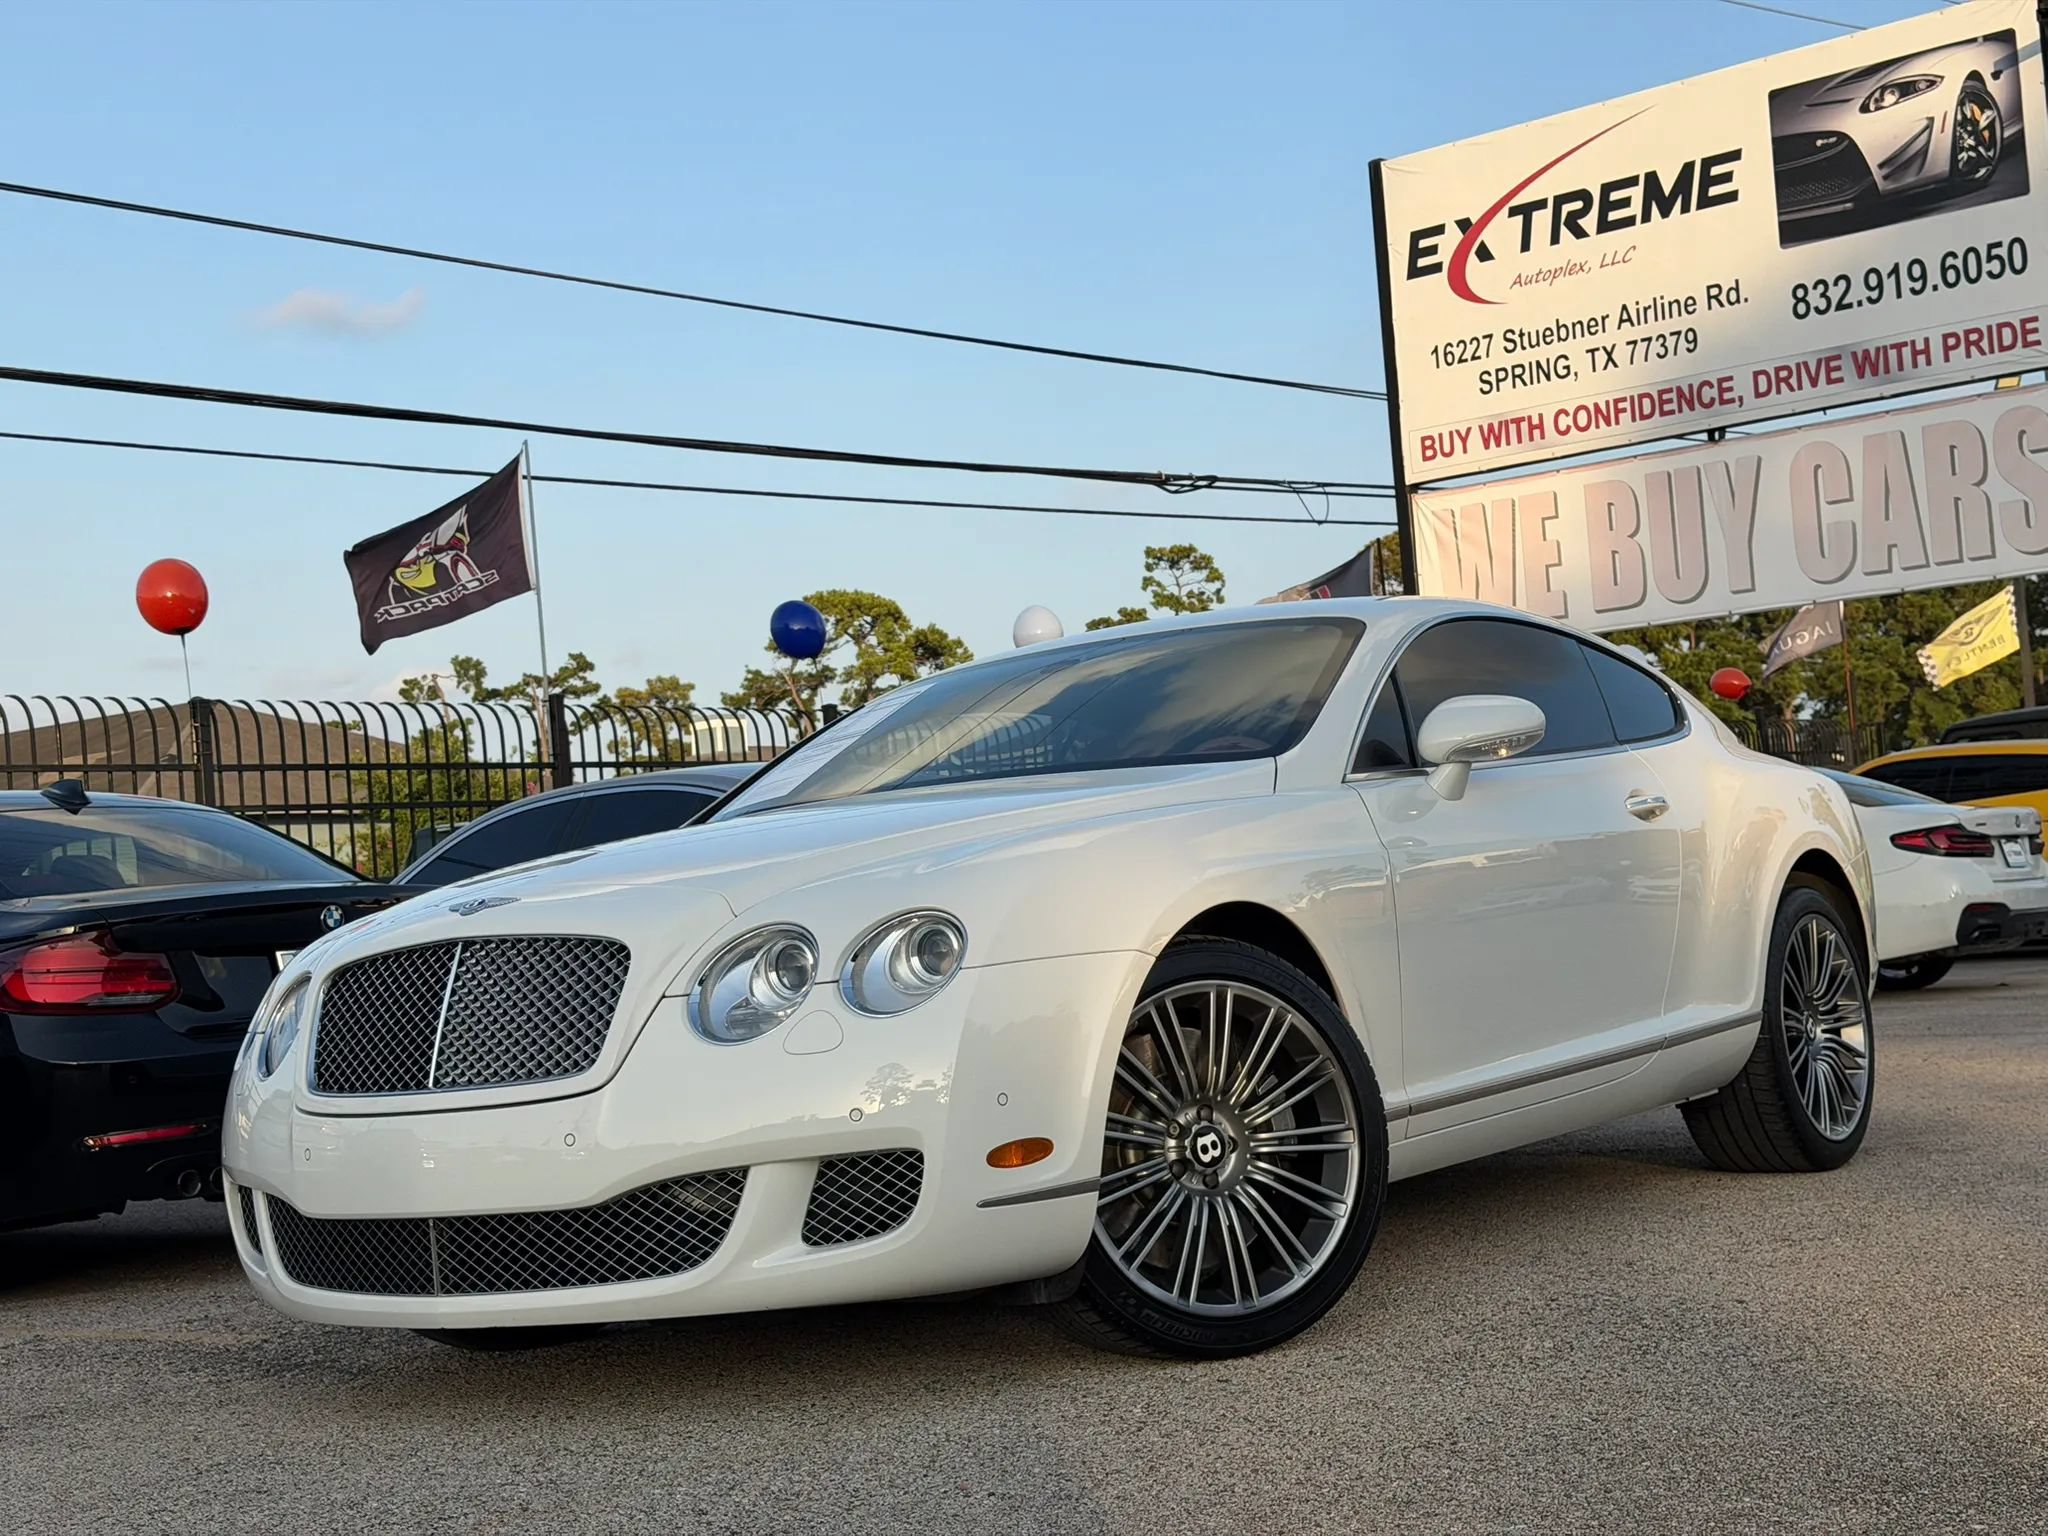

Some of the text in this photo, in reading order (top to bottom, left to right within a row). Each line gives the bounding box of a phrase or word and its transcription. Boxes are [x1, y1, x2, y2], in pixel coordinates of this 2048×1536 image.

[1406, 148, 1743, 280] EXTREME
[1509, 245, 1637, 290] Autoplex, LLC
[1791, 236, 2028, 320] 832.919.6050
[1430, 279, 1749, 369] 16227 Stuebner Airline Rd.
[1479, 328, 1698, 395] SPRING, TX 77379
[1420, 315, 2042, 462] BUY WITH CONFIDENCE, DRIVE WITH PRIDE
[1432, 405, 2048, 619] WE BUY CARS
